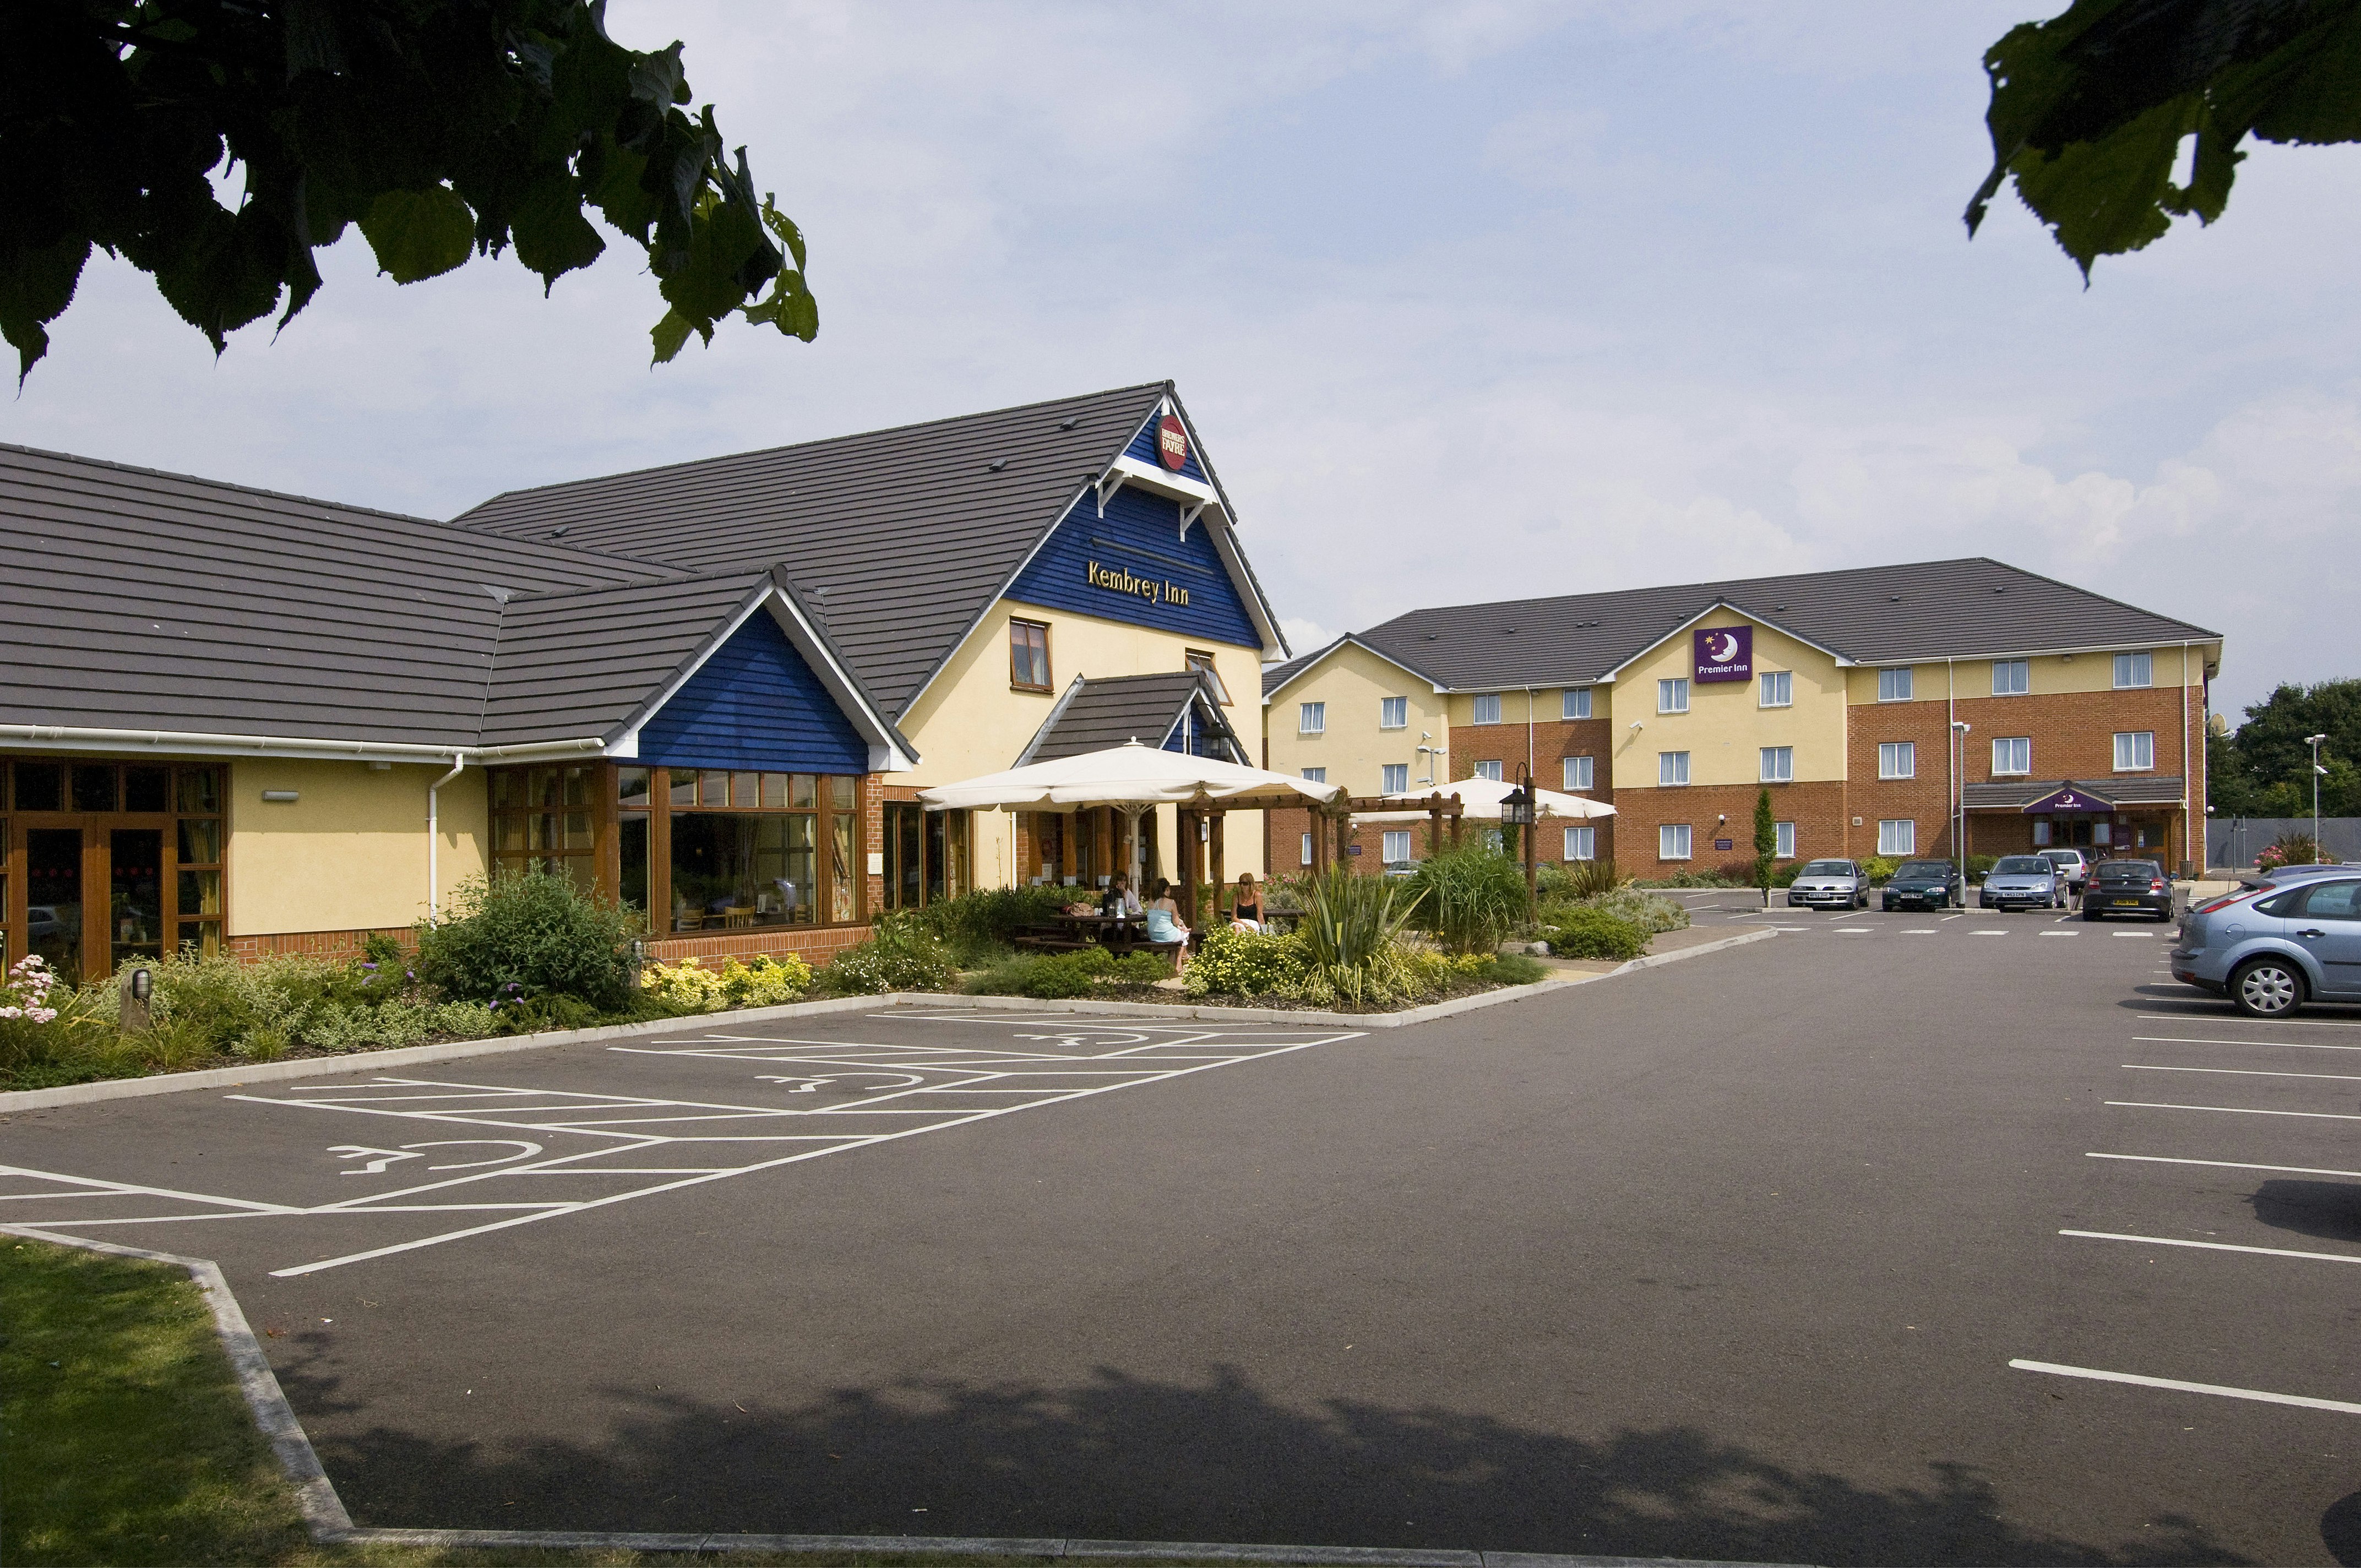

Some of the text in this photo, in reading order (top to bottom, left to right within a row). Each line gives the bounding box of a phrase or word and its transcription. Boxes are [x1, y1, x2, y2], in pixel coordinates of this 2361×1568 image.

[1162, 428, 1185, 444] BREWERS
[1162, 437, 1185, 456] FAYRE
[1088, 560, 1189, 605] Kembrey Inn
[1698, 665, 1733, 674] Premier
